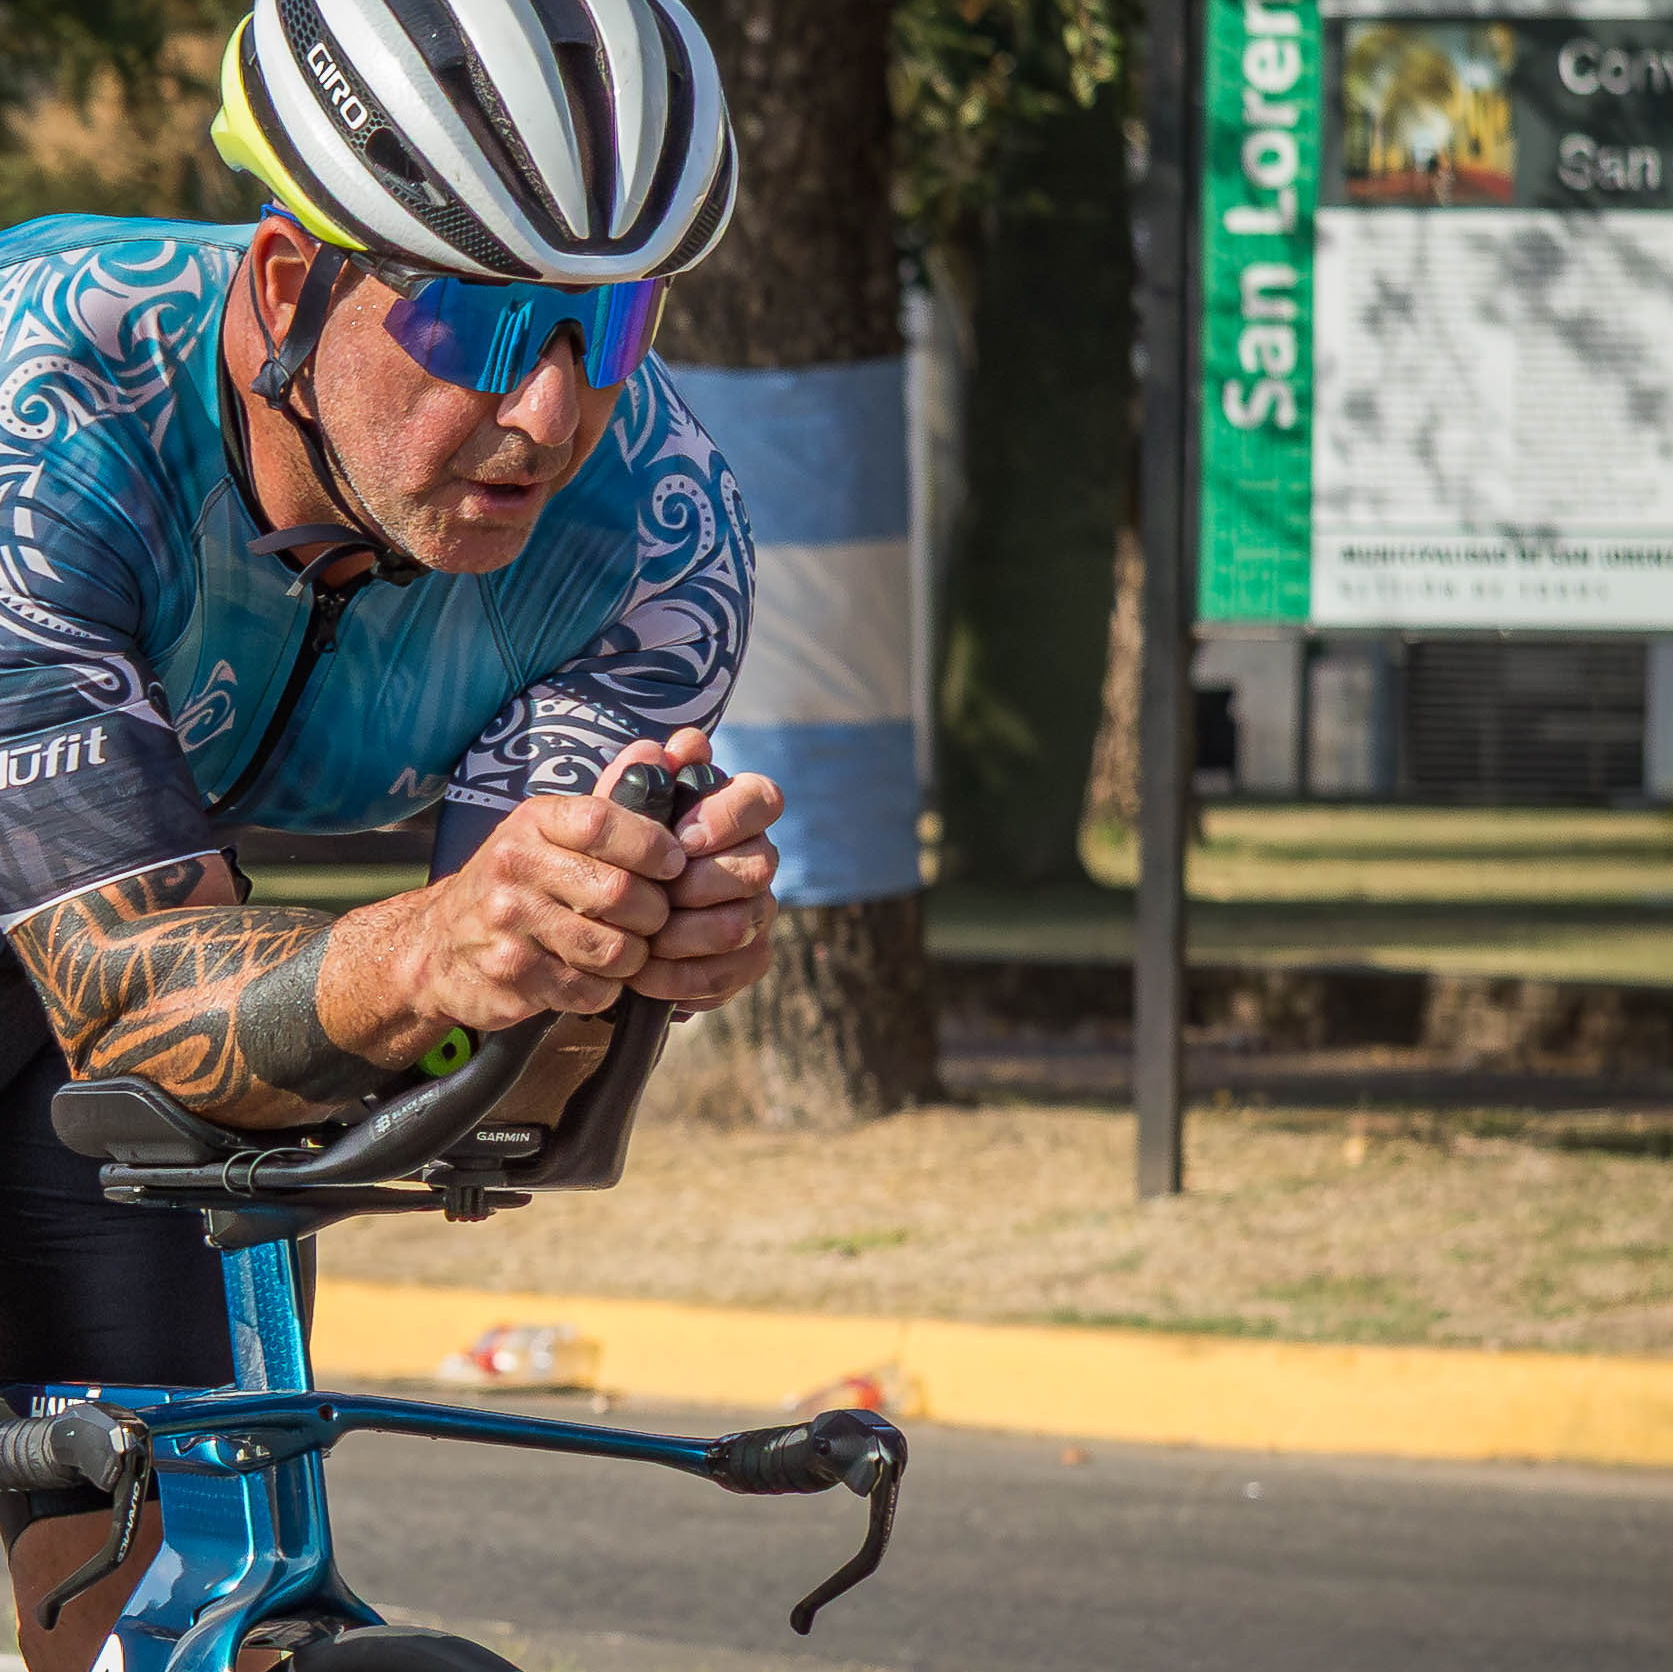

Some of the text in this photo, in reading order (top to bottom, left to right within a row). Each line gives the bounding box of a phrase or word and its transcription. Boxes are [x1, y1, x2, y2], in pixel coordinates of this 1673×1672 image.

[307, 42, 368, 130] GIRO
[1558, 39, 1673, 95] Con
[1558, 132, 1662, 192] San
[1223, 263, 1299, 429] San
[476, 1131, 531, 1142] GARMIN
